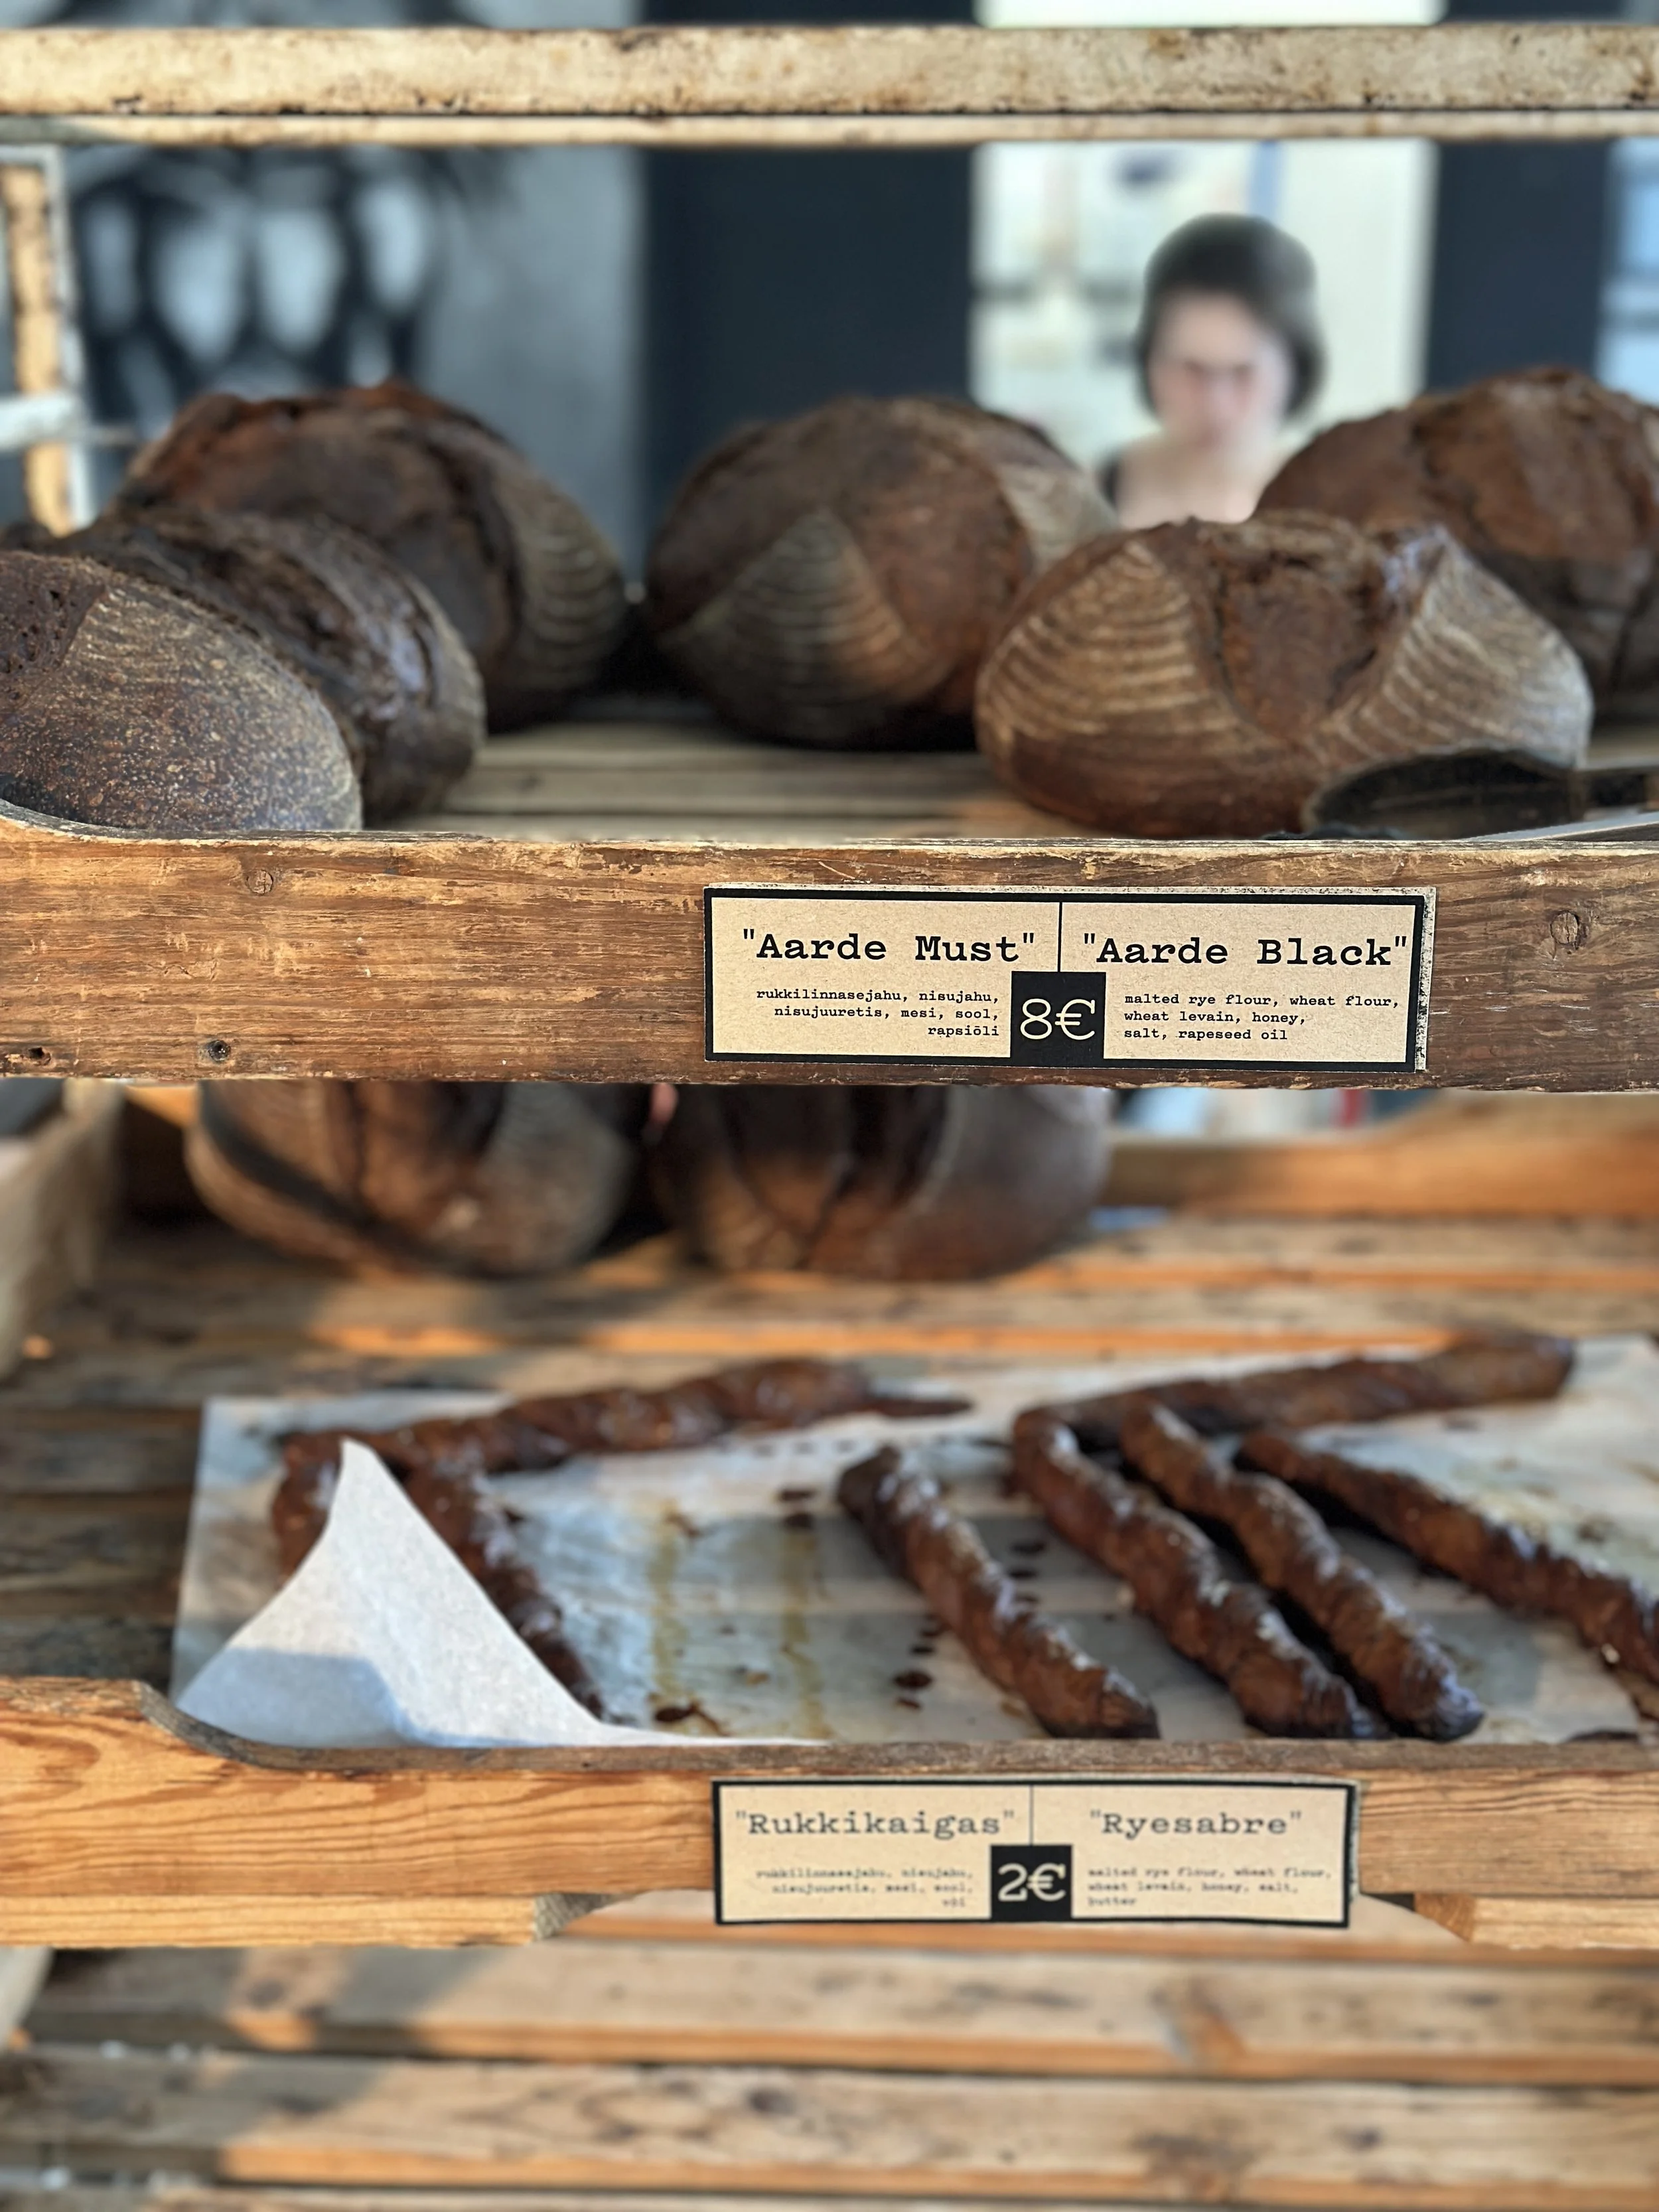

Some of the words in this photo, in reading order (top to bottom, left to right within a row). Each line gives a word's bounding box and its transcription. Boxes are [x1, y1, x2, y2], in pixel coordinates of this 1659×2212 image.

[743, 928, 886, 960] "Aarde
[915, 933, 1035, 962] Must"
[1084, 932, 1228, 964] "Aarde
[1257, 936, 1407, 966] Black"
[757, 989, 908, 1002] rukkilinnasejahu,
[919, 991, 999, 1003] nisujahu,
[1125, 994, 1179, 1005] malted
[1189, 995, 1216, 1006] rye
[1226, 994, 1278, 1007] flour,
[1290, 995, 1335, 1006] wheat
[1345, 995, 1399, 1008] flour,
[774, 1006, 889, 1019] nisujuuretis,
[901, 1008, 944, 1019] mesi,
[956, 1009, 999, 1020] sool,
[1020, 997, 1096, 1041] 8€
[1125, 1011, 1169, 1021] wheat
[1180, 1011, 1240, 1023] levain,
[1252, 1012, 1305, 1025] honey,
[1124, 1028, 1167, 1040] salt,
[1179, 1029, 1251, 1041] rapeseed
[1262, 1029, 1287, 1040] oil
[735, 1810, 1014, 1839] "Rukkikaigas"
[1090, 1809, 1301, 1839] "Ryesabre"
[997, 1862, 1066, 1901] 2€
